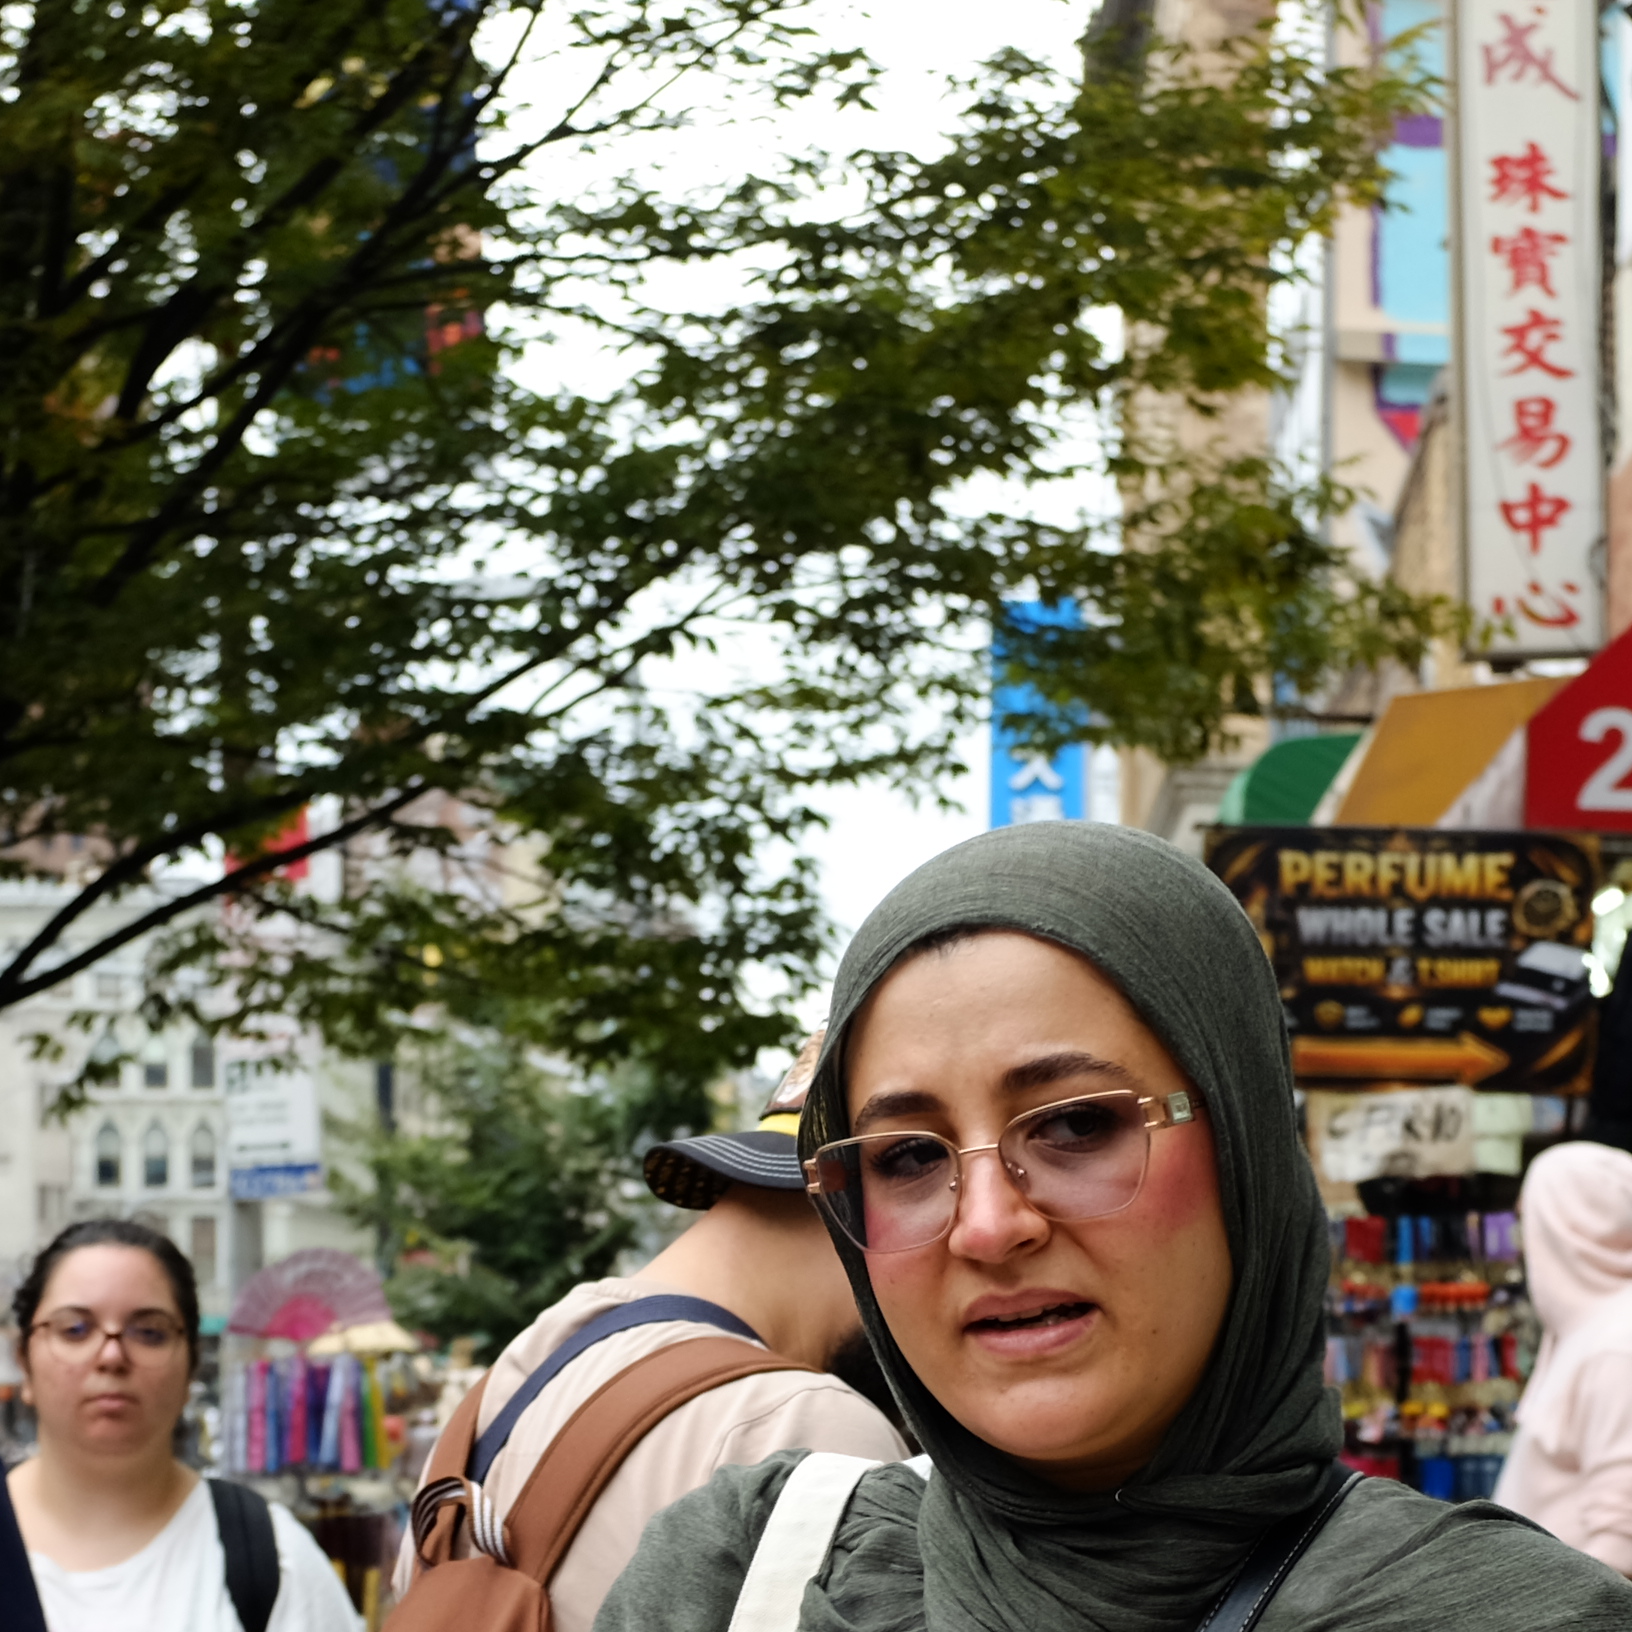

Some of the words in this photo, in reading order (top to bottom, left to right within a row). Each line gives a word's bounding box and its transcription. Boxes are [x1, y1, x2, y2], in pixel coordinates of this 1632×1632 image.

[1277, 849, 1516, 900] PERFUME
[1295, 906, 1414, 947] WHOLE
[1423, 907, 1508, 947] SALE
[1387, 956, 1414, 986] &
